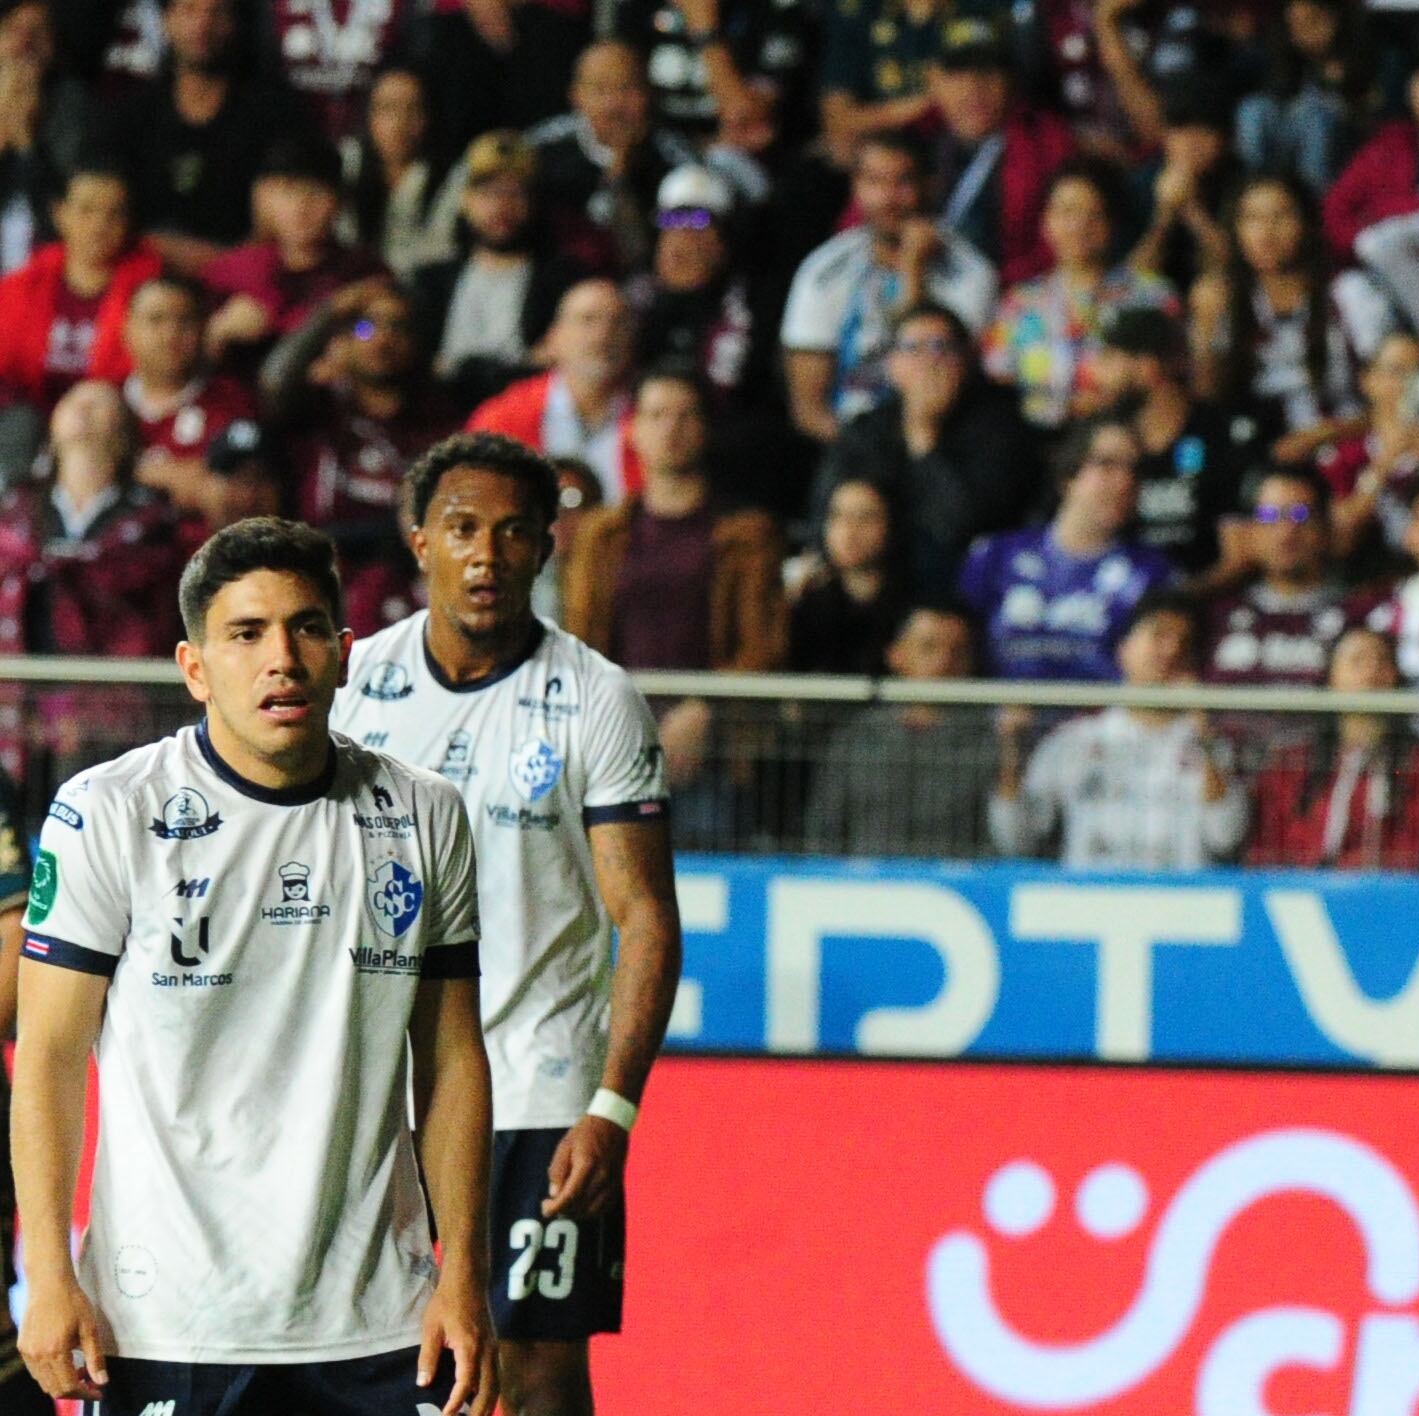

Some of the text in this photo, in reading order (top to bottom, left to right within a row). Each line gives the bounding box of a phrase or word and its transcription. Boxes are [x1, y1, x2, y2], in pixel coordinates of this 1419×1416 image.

[152, 972, 233, 986] San Marcos
[507, 1218, 579, 1300] 23
